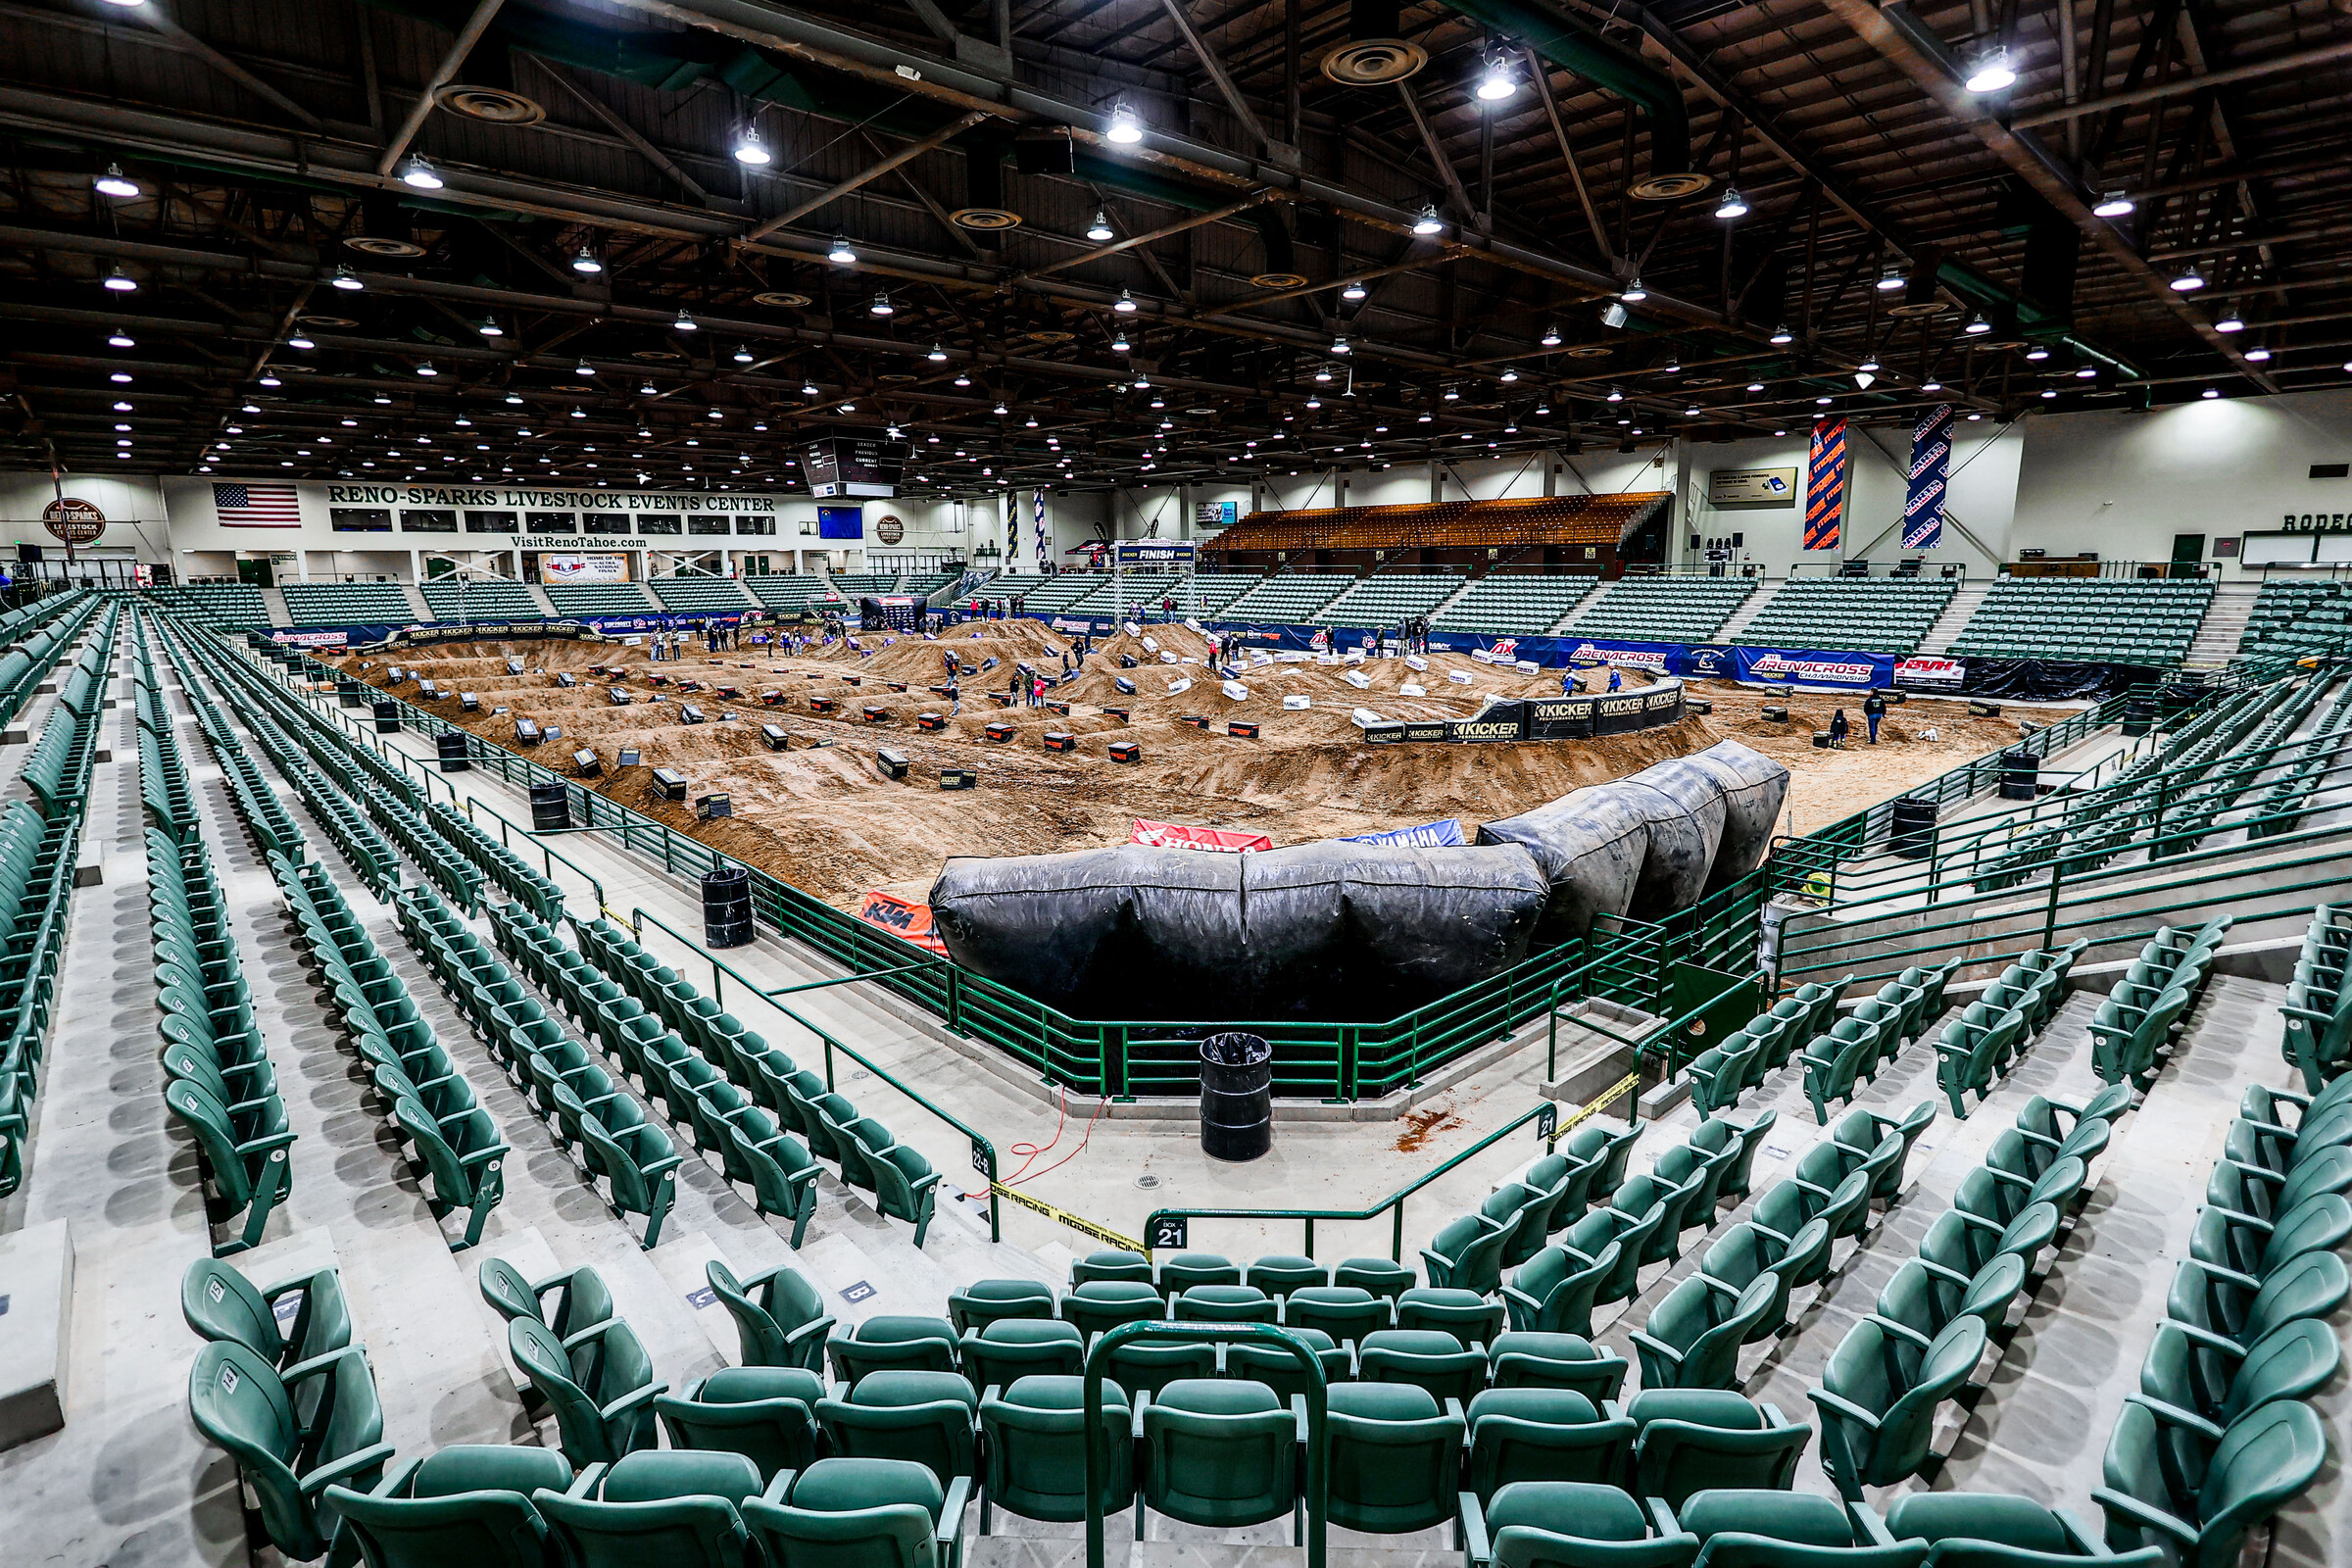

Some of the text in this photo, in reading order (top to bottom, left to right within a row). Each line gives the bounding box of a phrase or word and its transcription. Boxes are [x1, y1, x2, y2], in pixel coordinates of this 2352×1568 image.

[1909, 442, 1944, 476] PARTS
[1911, 446, 1947, 479] UNLIMITED
[327, 486, 775, 512] RENO-SPARKS LIVESTOCK EVENTS CENTER
[1905, 480, 1940, 514] PARTS
[1907, 483, 1943, 516] UNLIMITED
[511, 536, 647, 548] VisitRenoTahoe.com
[1139, 550, 1175, 560] FINISH
[272, 632, 347, 642] ARENACROSS
[1571, 649, 1666, 662] ARENACROSS
[1753, 661, 1872, 675] ARENACROSS
[1799, 672, 1870, 681] CHAMPIONSHIP
[1608, 698, 1643, 712] KICKER
[1652, 691, 1678, 707] KICKER
[1546, 703, 1592, 716] KICKER
[1465, 723, 1518, 734] KICKER
[864, 900, 914, 929] KTM
[1541, 1117, 1553, 1136] 21
[973, 1154, 989, 1175] 22-B
[1011, 1193, 1051, 1216] RACING
[1058, 1214, 1100, 1240] MOOSE
[1158, 1228, 1182, 1246] 21
[211, 1284, 221, 1298] 15
[223, 1373, 234, 1389] 14
